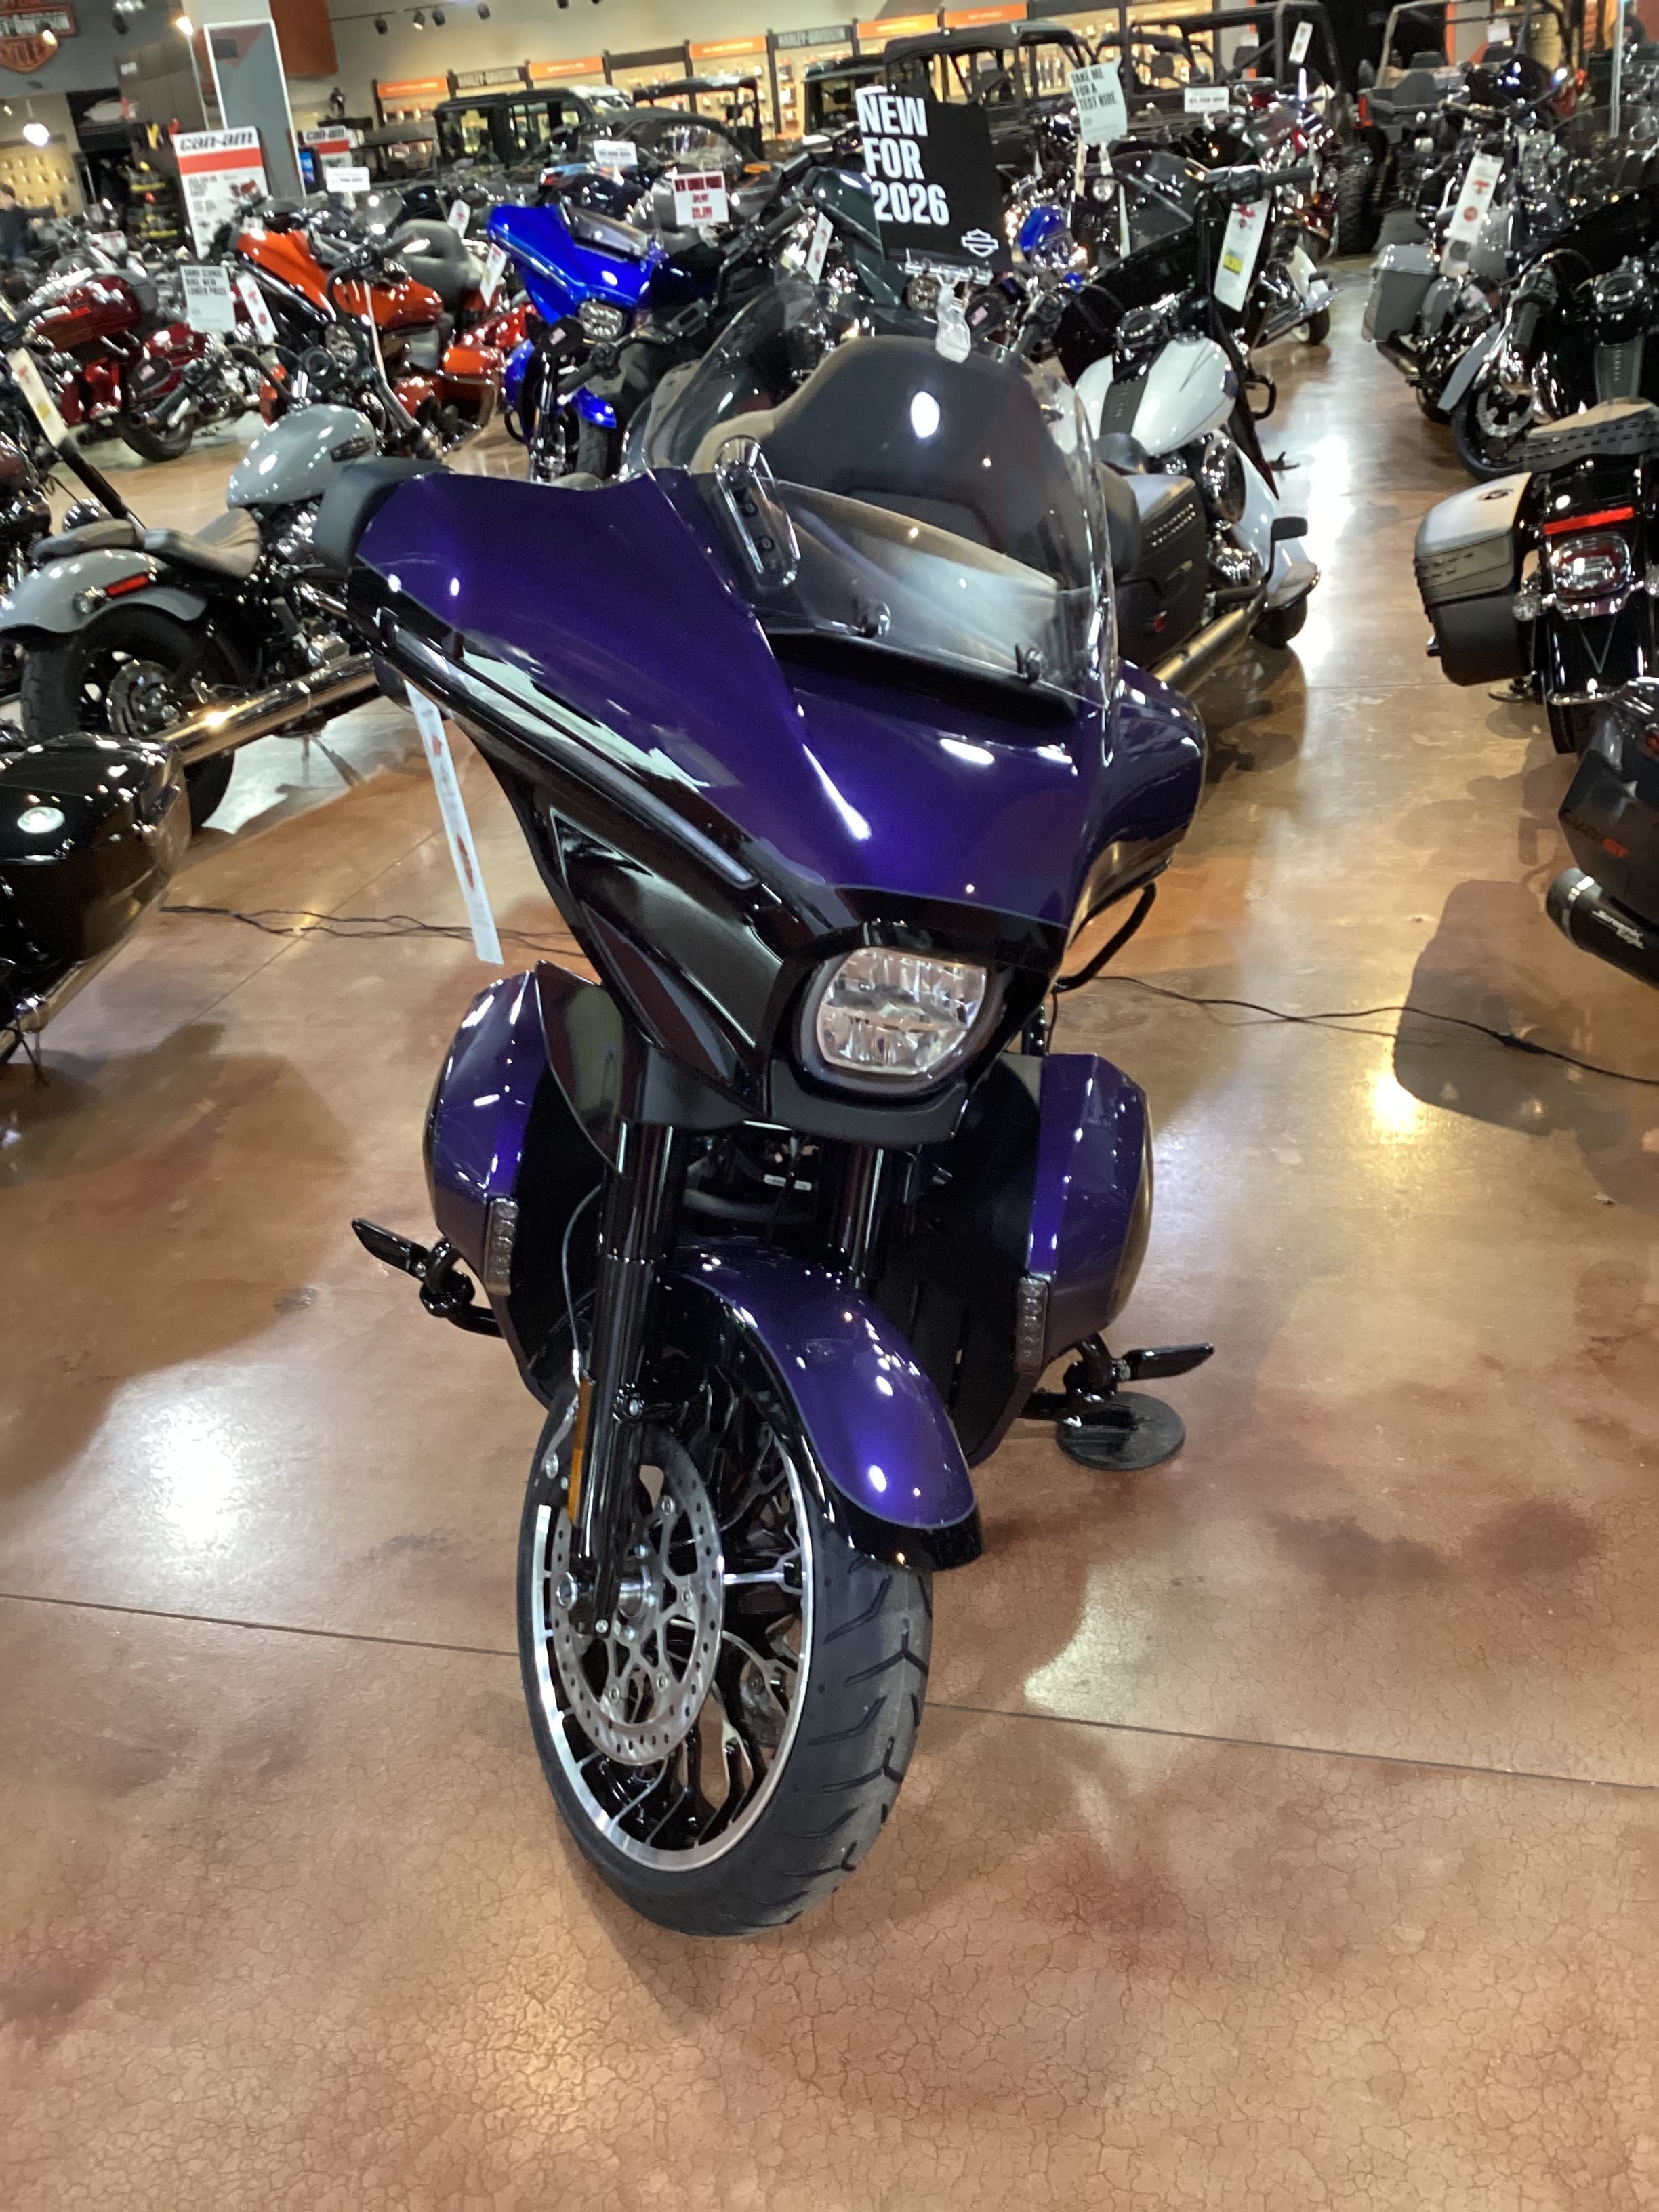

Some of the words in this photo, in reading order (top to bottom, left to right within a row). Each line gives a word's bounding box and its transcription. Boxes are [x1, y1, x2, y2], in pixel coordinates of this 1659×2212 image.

[1071, 70, 1090, 84] TAKE
[1090, 67, 1104, 80] ME
[1074, 84, 1091, 98] FOR
[1091, 83, 1098, 94] A
[856, 94, 928, 136] NEW
[862, 136, 926, 180] FOR
[870, 180, 950, 226] 2026
